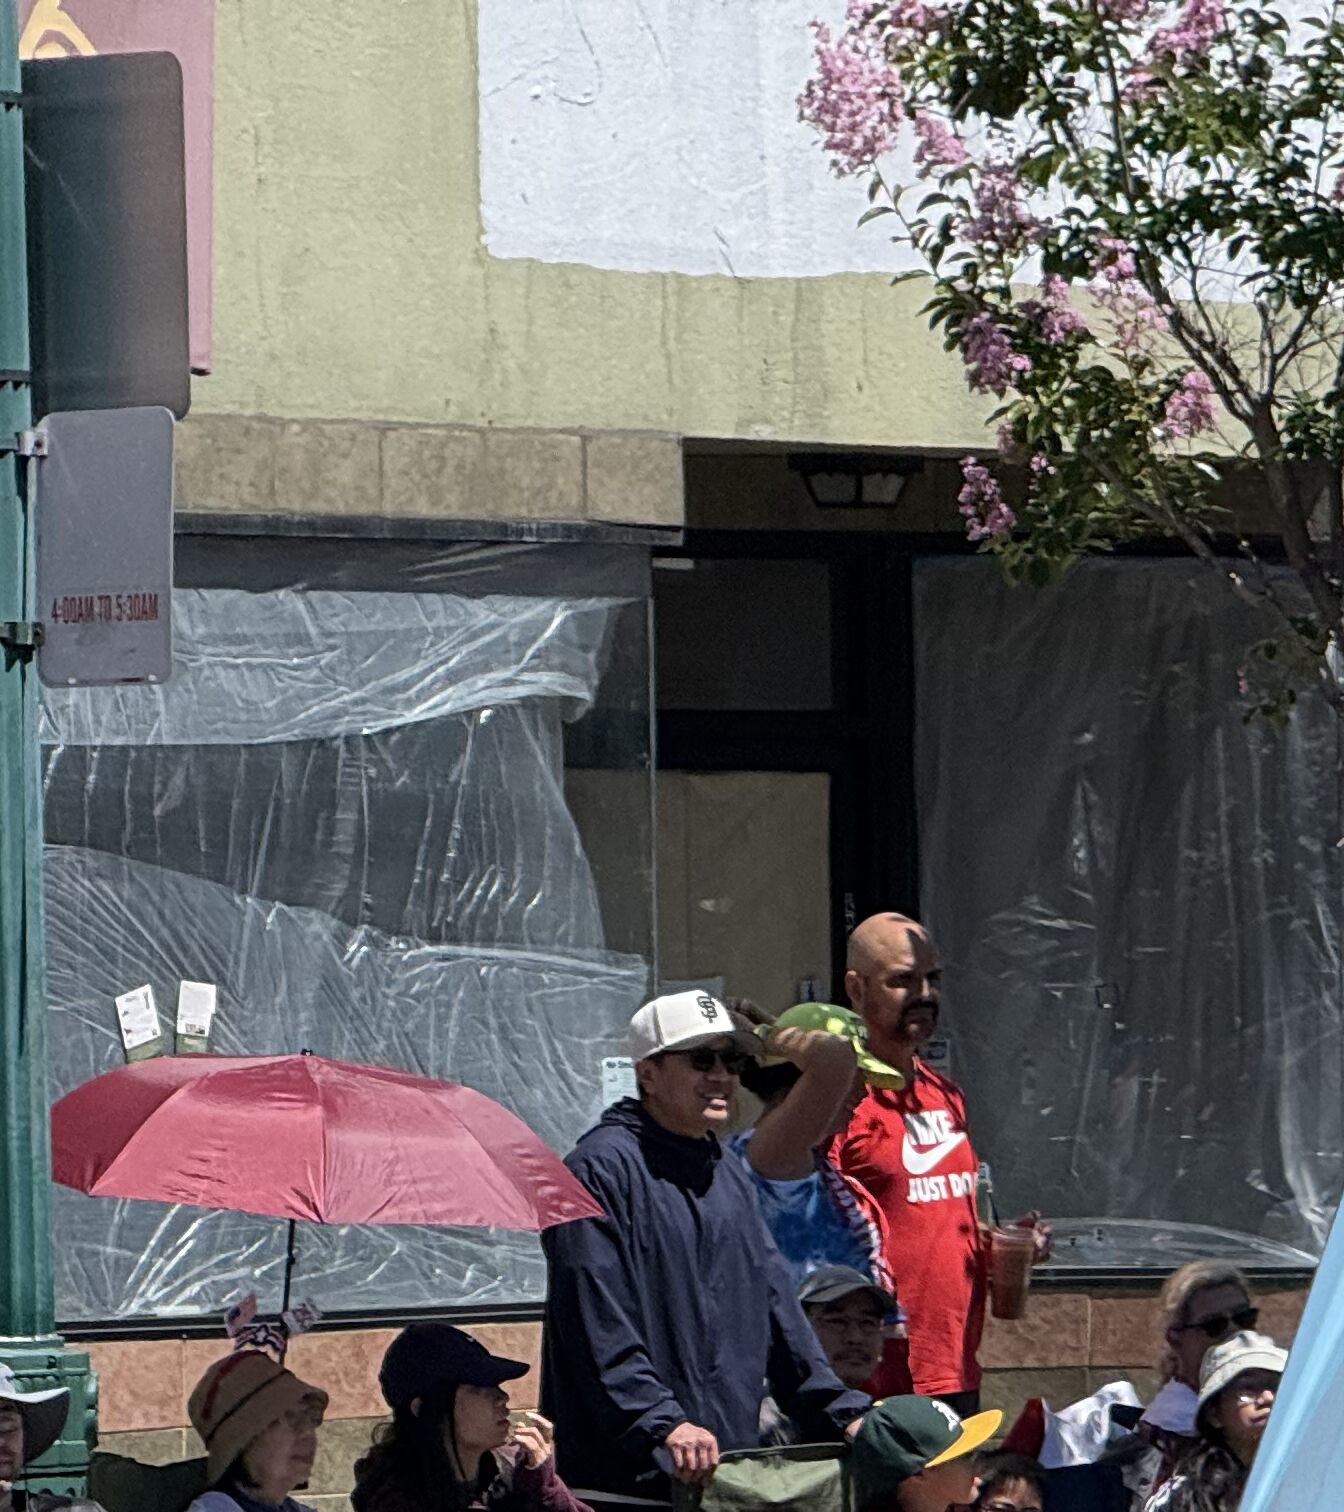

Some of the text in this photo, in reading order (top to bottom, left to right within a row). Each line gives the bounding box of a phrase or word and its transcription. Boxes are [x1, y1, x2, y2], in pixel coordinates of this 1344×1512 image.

[52, 593, 159, 624] 4:00AM TO 5:30AM
[904, 1109, 954, 1146] NIKE
[906, 1175, 948, 1204] JUST
